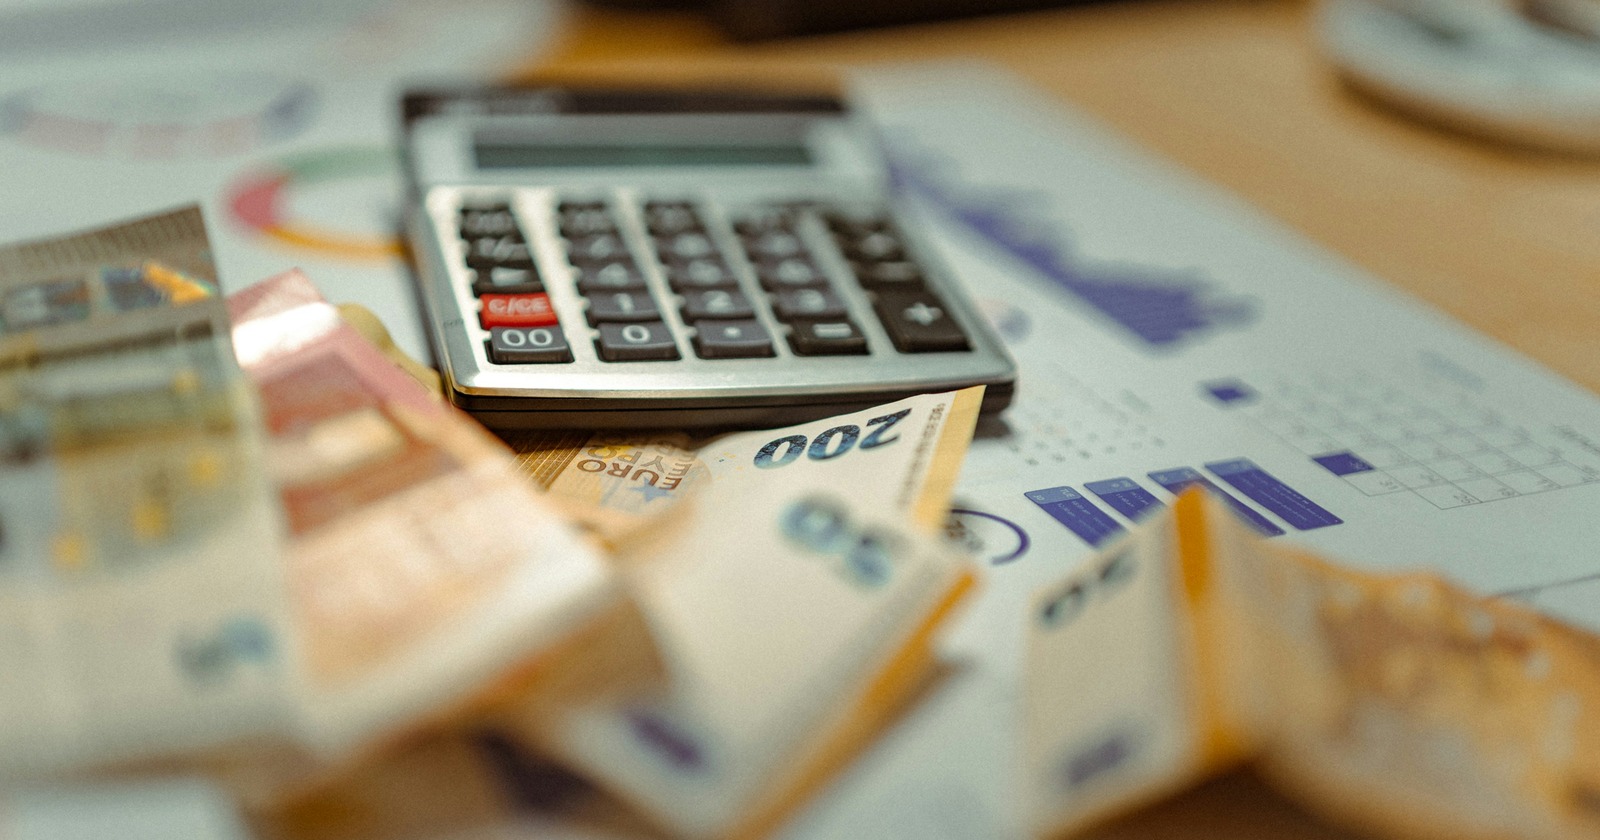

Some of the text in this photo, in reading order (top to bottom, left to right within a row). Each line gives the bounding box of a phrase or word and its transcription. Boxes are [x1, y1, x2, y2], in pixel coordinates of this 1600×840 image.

[488, 297, 549, 316] C/CE
[501, 328, 553, 347] 00
[622, 324, 651, 345] 0
[753, 408, 912, 469] 200
[577, 459, 682, 490] EURO
